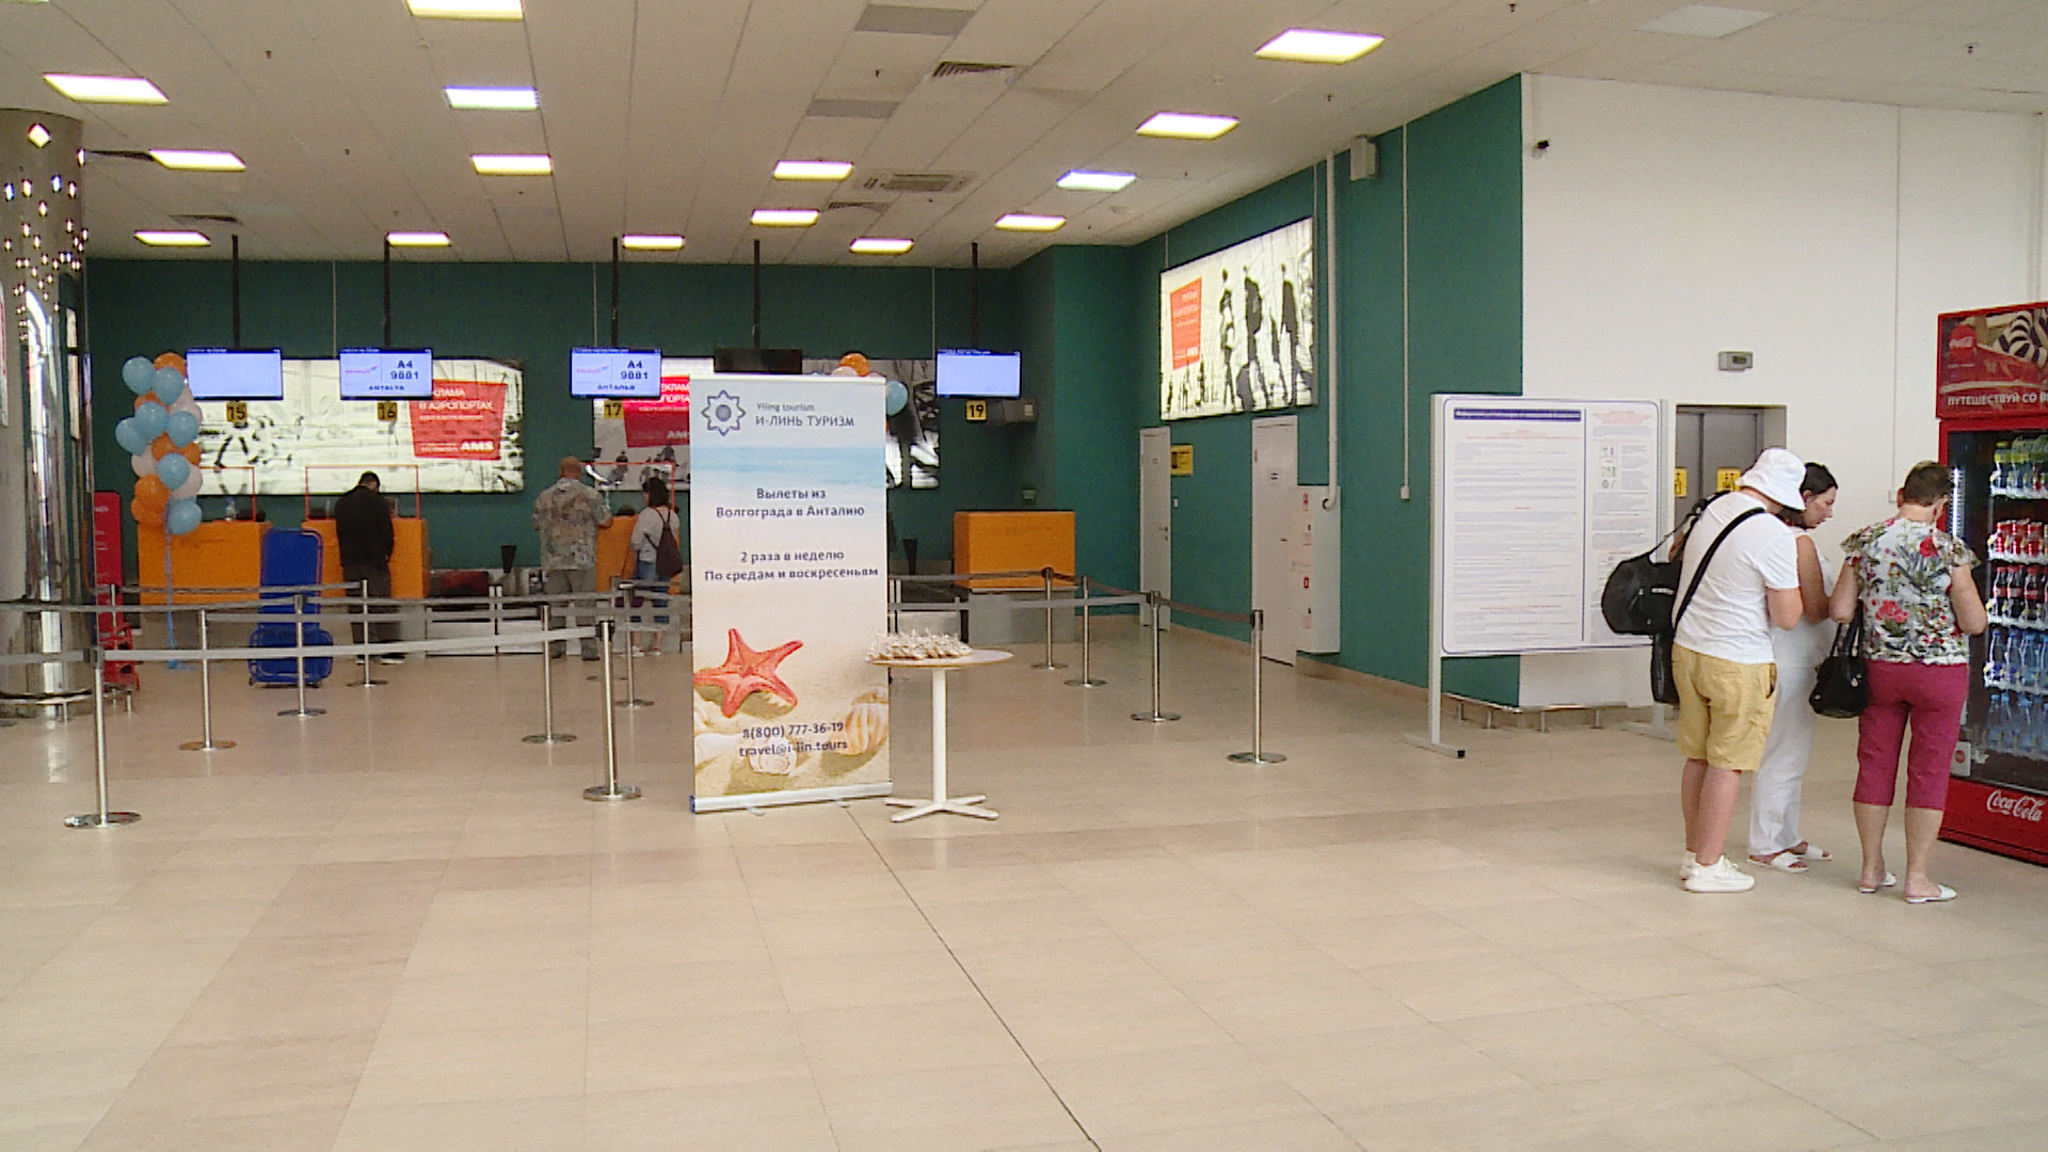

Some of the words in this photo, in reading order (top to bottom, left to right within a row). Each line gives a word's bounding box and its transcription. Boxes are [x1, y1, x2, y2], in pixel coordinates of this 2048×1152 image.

[397, 359, 413, 369] A4
[627, 359, 643, 369] A4
[2022, 391, 2037, 403] СО
[228, 405, 246, 420] 15
[378, 404, 396, 420] 16
[605, 403, 622, 417] 17
[968, 404, 985, 418] 19
[755, 415, 803, 427] И-ЛИНЬ
[807, 415, 855, 427] ТУРИЗМ
[461, 441, 494, 451] AMS
[756, 488, 808, 499] Вылеты
[811, 489, 826, 499] из
[716, 507, 793, 519] Волгограда
[796, 509, 803, 517] в
[806, 505, 865, 517] Анталию
[741, 552, 748, 562] 2
[751, 553, 781, 564] раза
[784, 553, 791, 561] в
[794, 551, 845, 562] неделю
[705, 571, 723, 581] По
[726, 571, 775, 583] средам
[778, 571, 786, 579] и
[789, 568, 879, 580] воскресеньям
[742, 726, 785, 740] 8(800)
[788, 722, 844, 736] 777-36-19
[739, 740, 848, 757] travel@i-lin.tours
